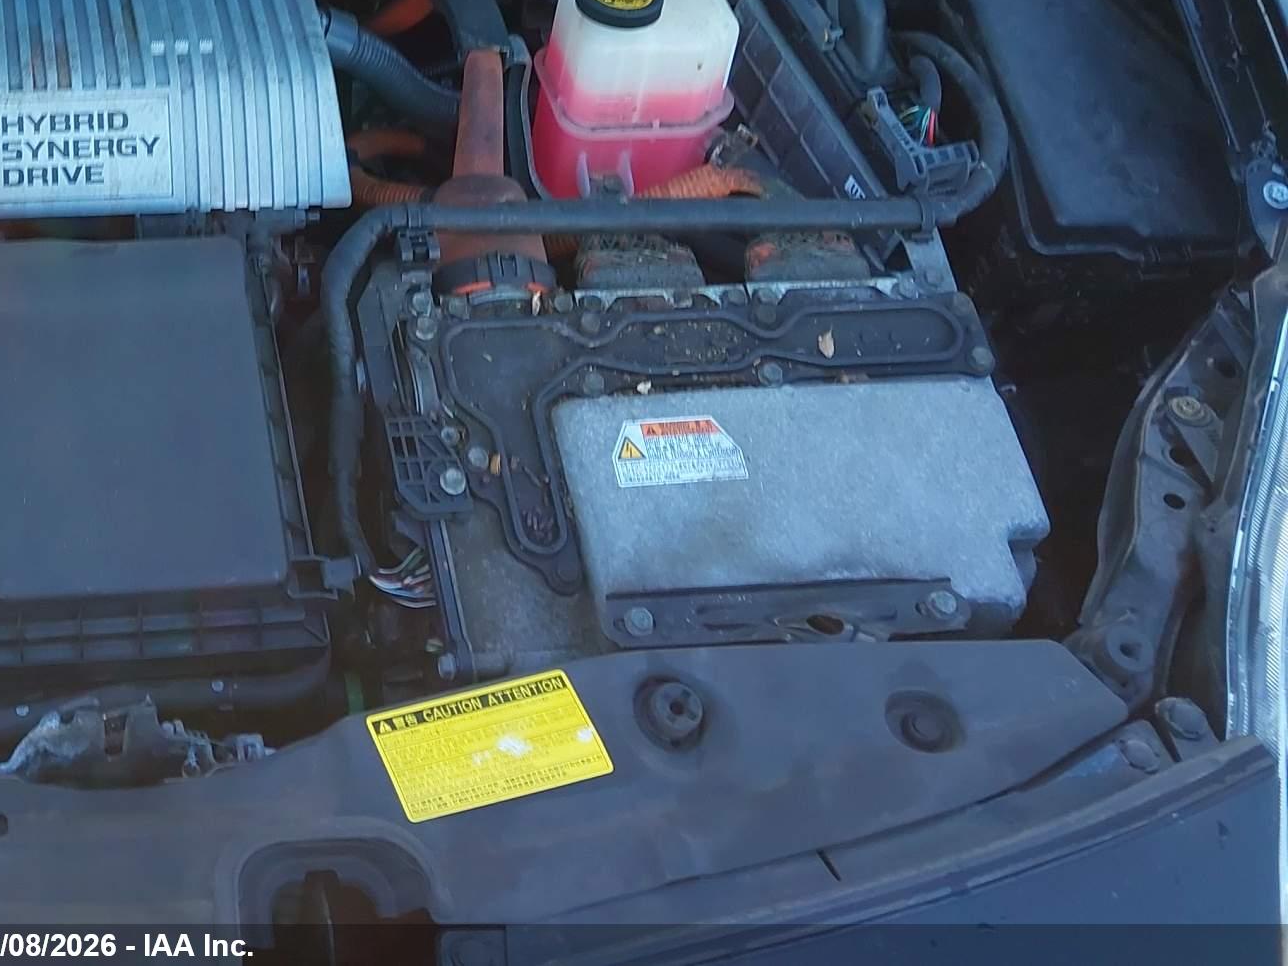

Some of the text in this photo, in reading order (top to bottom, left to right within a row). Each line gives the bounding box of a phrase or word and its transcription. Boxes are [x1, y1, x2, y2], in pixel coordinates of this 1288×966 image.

[1, 112, 129, 135] HYBRID
[1, 136, 160, 162] SYNERGY
[2, 164, 105, 187] DRIVE
[423, 696, 483, 724] CAUTION
[488, 677, 564, 707] ATTENTION
